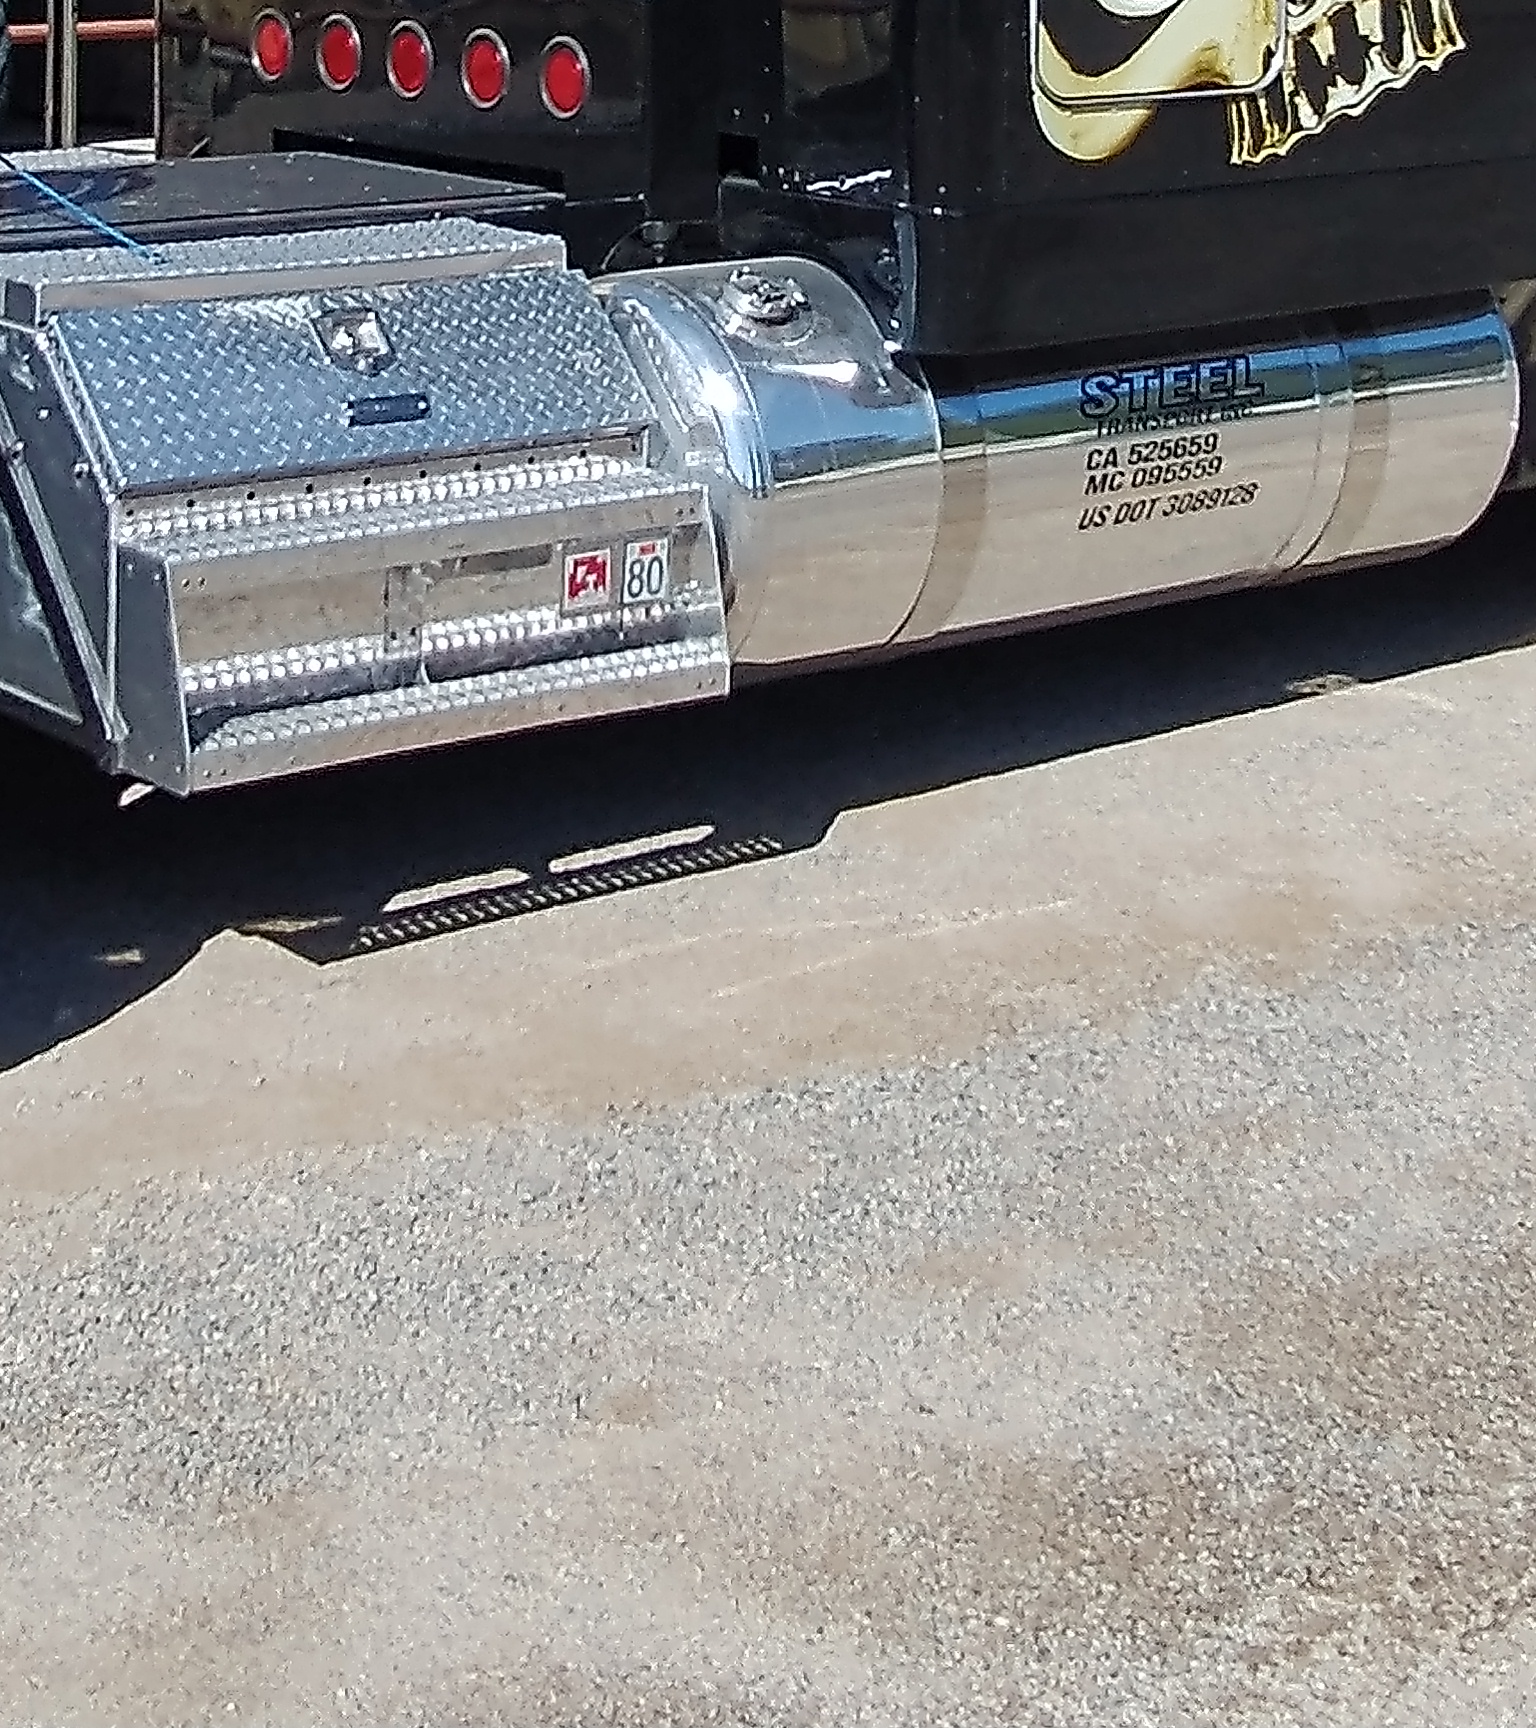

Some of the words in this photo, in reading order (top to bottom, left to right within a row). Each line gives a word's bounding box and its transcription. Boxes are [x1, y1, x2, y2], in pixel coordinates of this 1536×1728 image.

[1080, 354, 1264, 418] STEEL
[1086, 446, 1119, 471] CA
[1084, 470, 1125, 496] MC
[1077, 503, 1113, 531] US
[1113, 495, 1163, 526] DOT
[626, 555, 664, 599] 80
